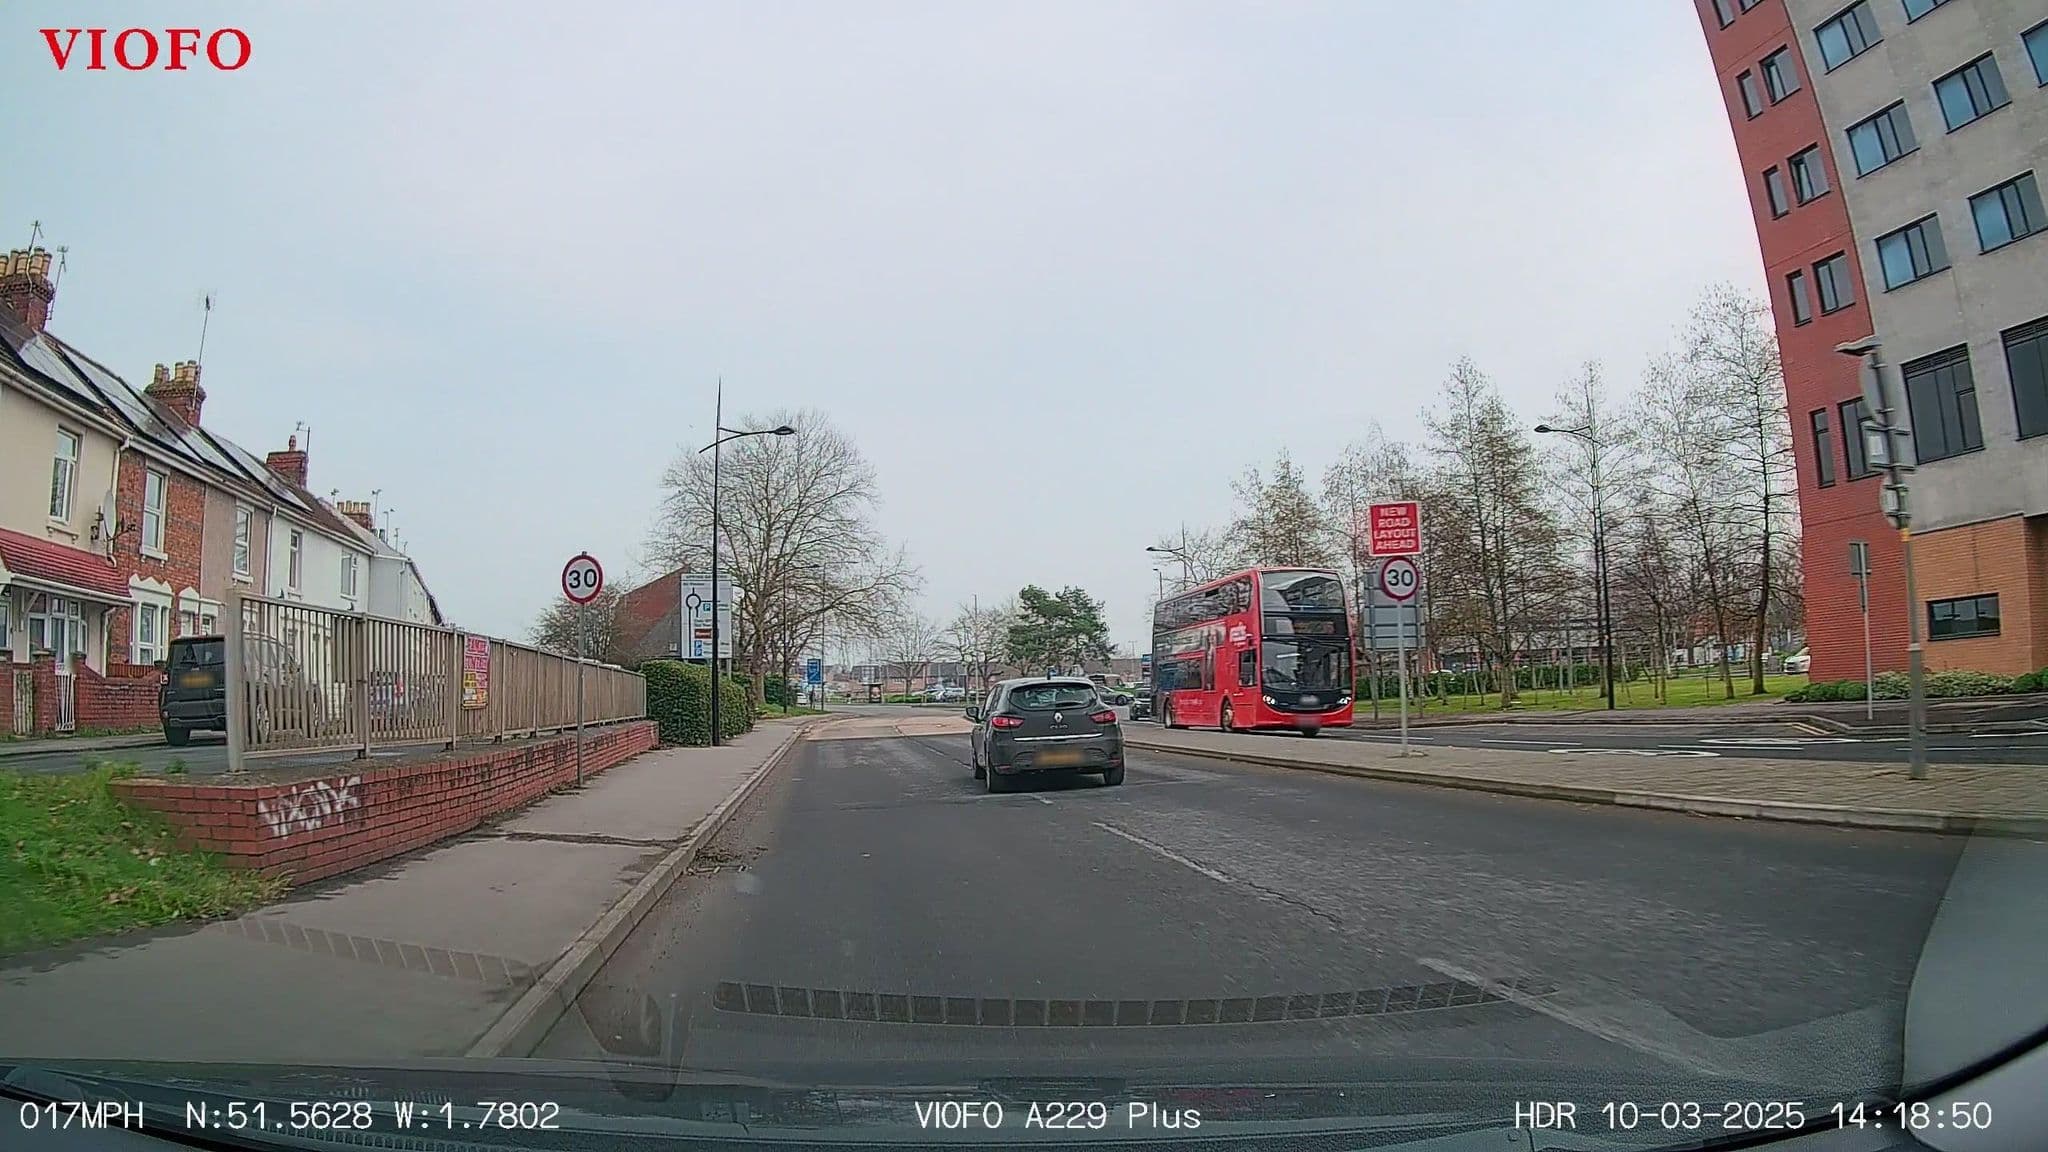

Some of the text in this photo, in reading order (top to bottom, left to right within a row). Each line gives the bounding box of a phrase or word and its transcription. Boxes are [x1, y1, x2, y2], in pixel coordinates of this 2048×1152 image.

[1380, 506, 1408, 517] NEW
[1378, 517, 1411, 528] ROAD
[1373, 528, 1417, 539] LAYOUT
[1375, 540, 1417, 550] AHEAD
[569, 569, 597, 588] 30
[1387, 569, 1414, 587] 30
